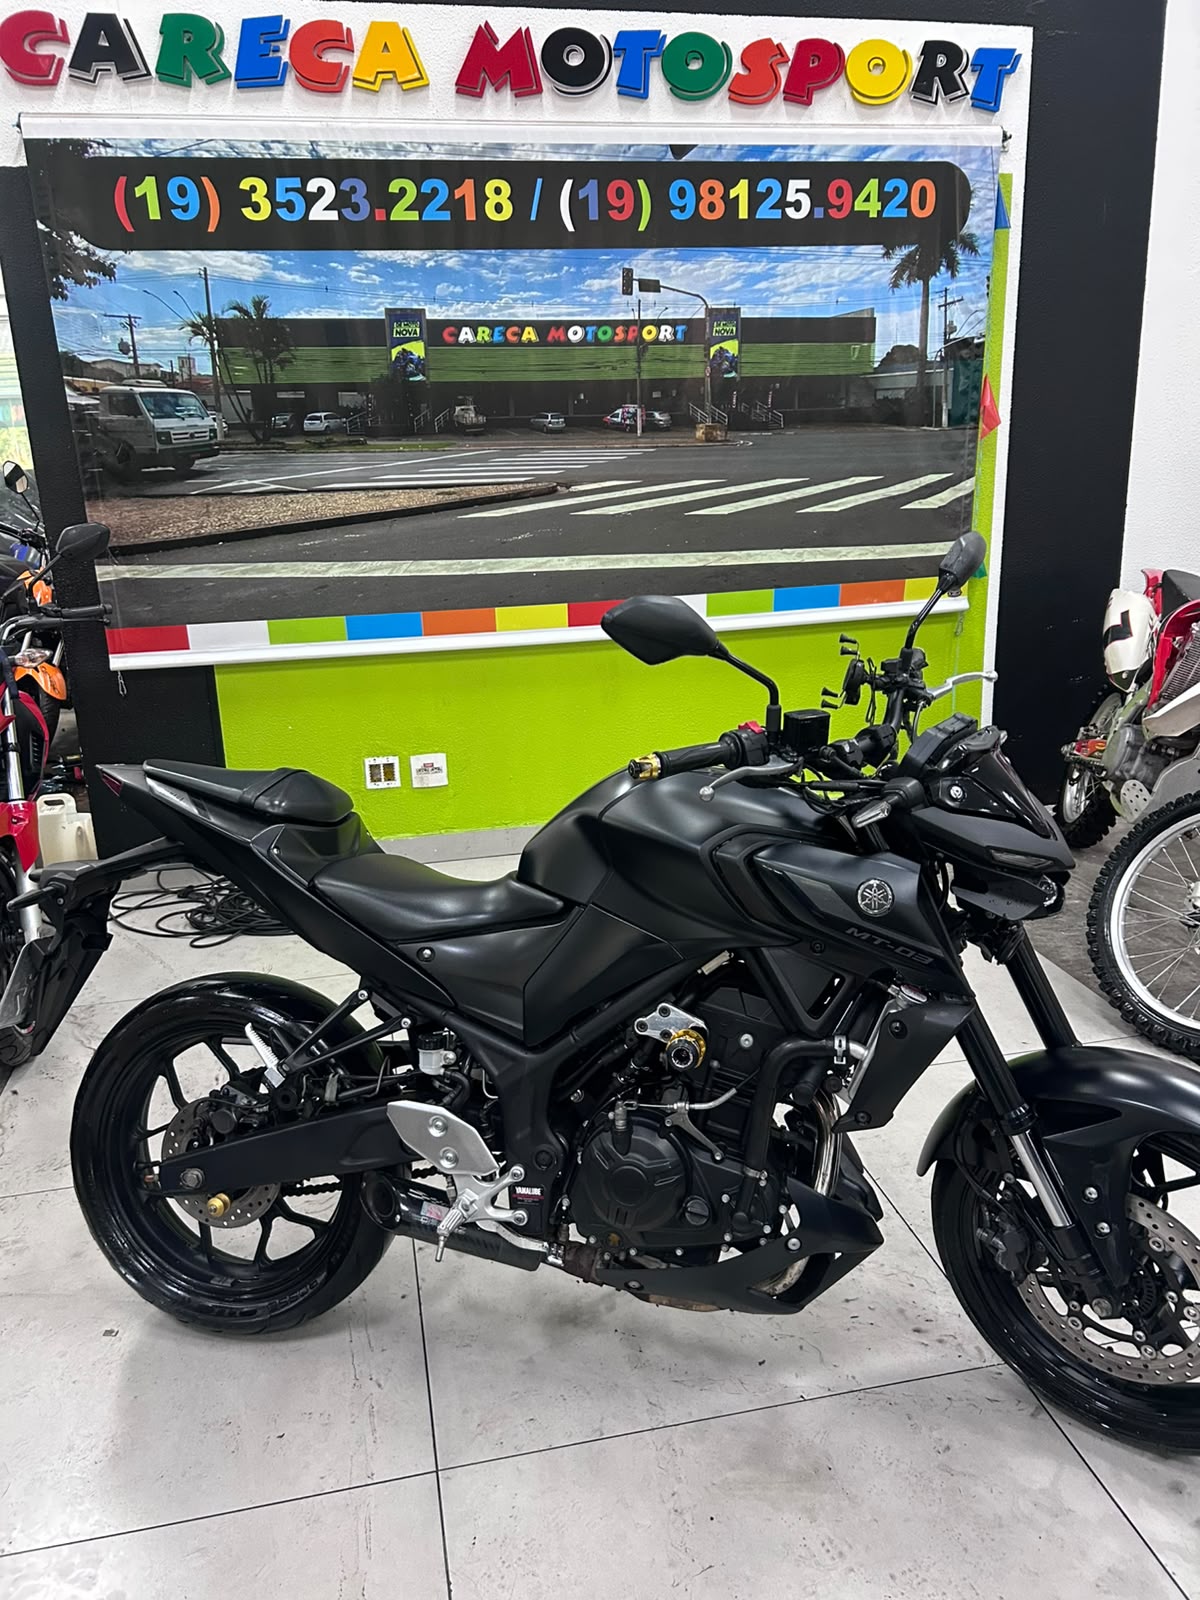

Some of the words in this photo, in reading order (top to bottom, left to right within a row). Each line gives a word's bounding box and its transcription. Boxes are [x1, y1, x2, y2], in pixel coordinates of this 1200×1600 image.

[0, 10, 430, 92] CARECA
[454, 20, 1022, 112] MOTOSPORT
[113, 175, 221, 233] (19)
[239, 177, 514, 222] 3523.2218
[559, 178, 652, 233] (19)
[669, 178, 936, 221] 98125.9420
[395, 328, 418, 336] NOVA
[442, 326, 540, 344] CARECA
[546, 324, 688, 343] MOTOSPORT
[714, 328, 734, 336] NOVA
[845, 927, 935, 964] MT-03
